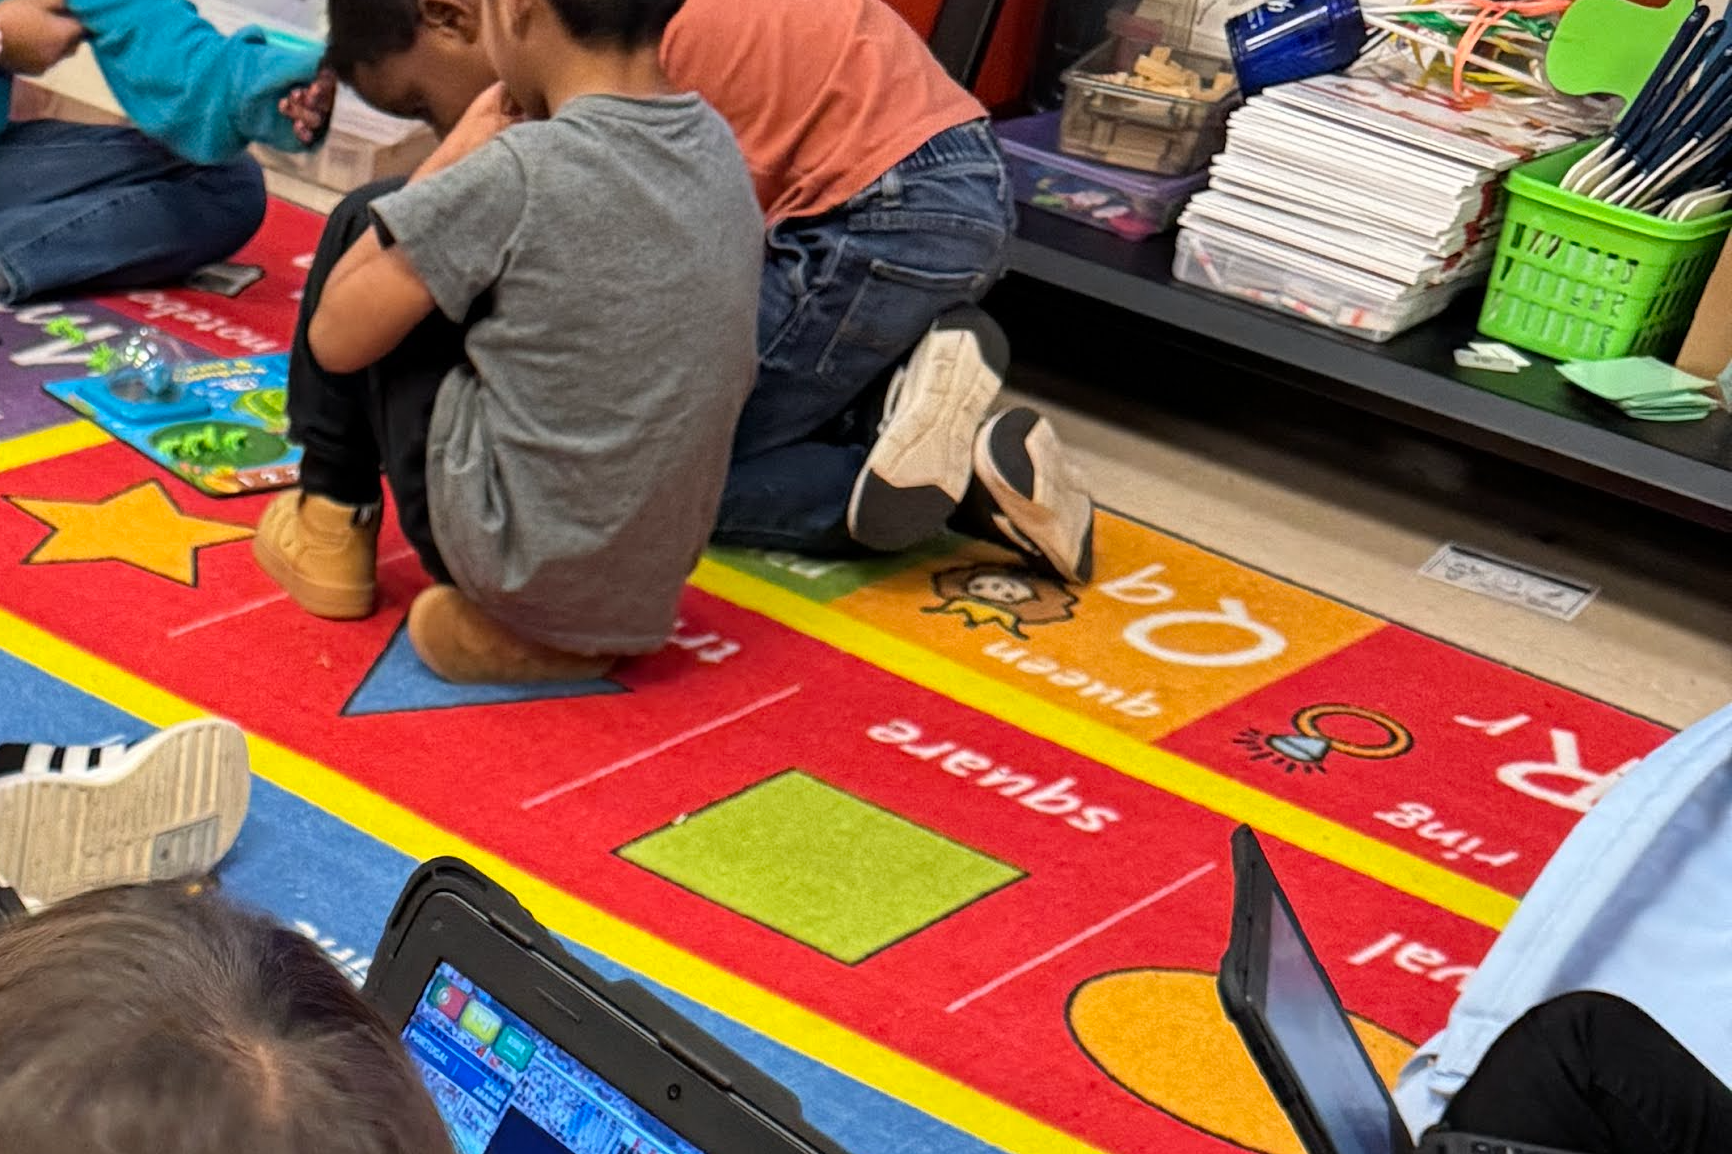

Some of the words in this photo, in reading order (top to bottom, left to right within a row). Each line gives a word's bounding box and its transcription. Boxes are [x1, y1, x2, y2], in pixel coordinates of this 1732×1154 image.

[980, 639, 1163, 718] queen
[867, 719, 1120, 833] square
[1373, 801, 1519, 867] ring
[1346, 932, 1481, 994] val
